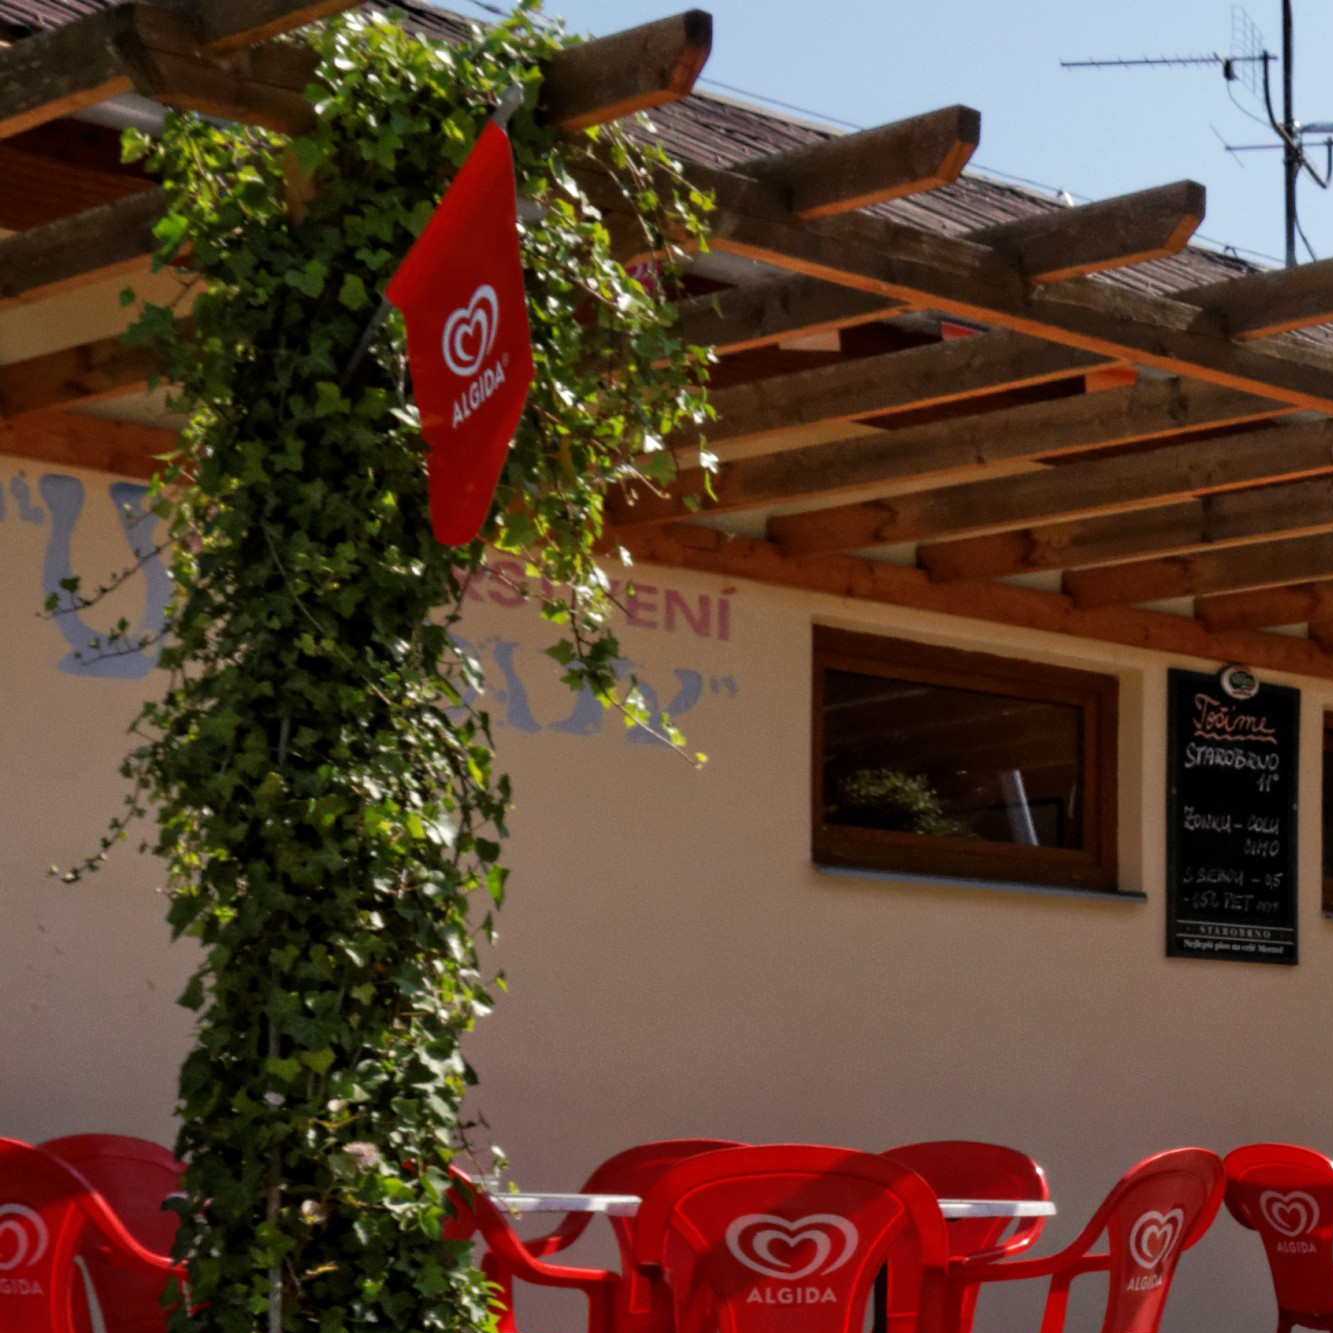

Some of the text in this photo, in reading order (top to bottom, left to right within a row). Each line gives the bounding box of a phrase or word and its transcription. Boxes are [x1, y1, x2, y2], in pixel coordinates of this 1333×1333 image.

[452, 360, 506, 430] ALGIDA
[1192, 692, 1277, 734] Točíme
[1198, 924, 1272, 939] STAROBRNO
[1276, 1240, 1319, 1254] ALGIDA
[1126, 1273, 1163, 1293] ALGIDA
[746, 1286, 839, 1305] ALGIDA
